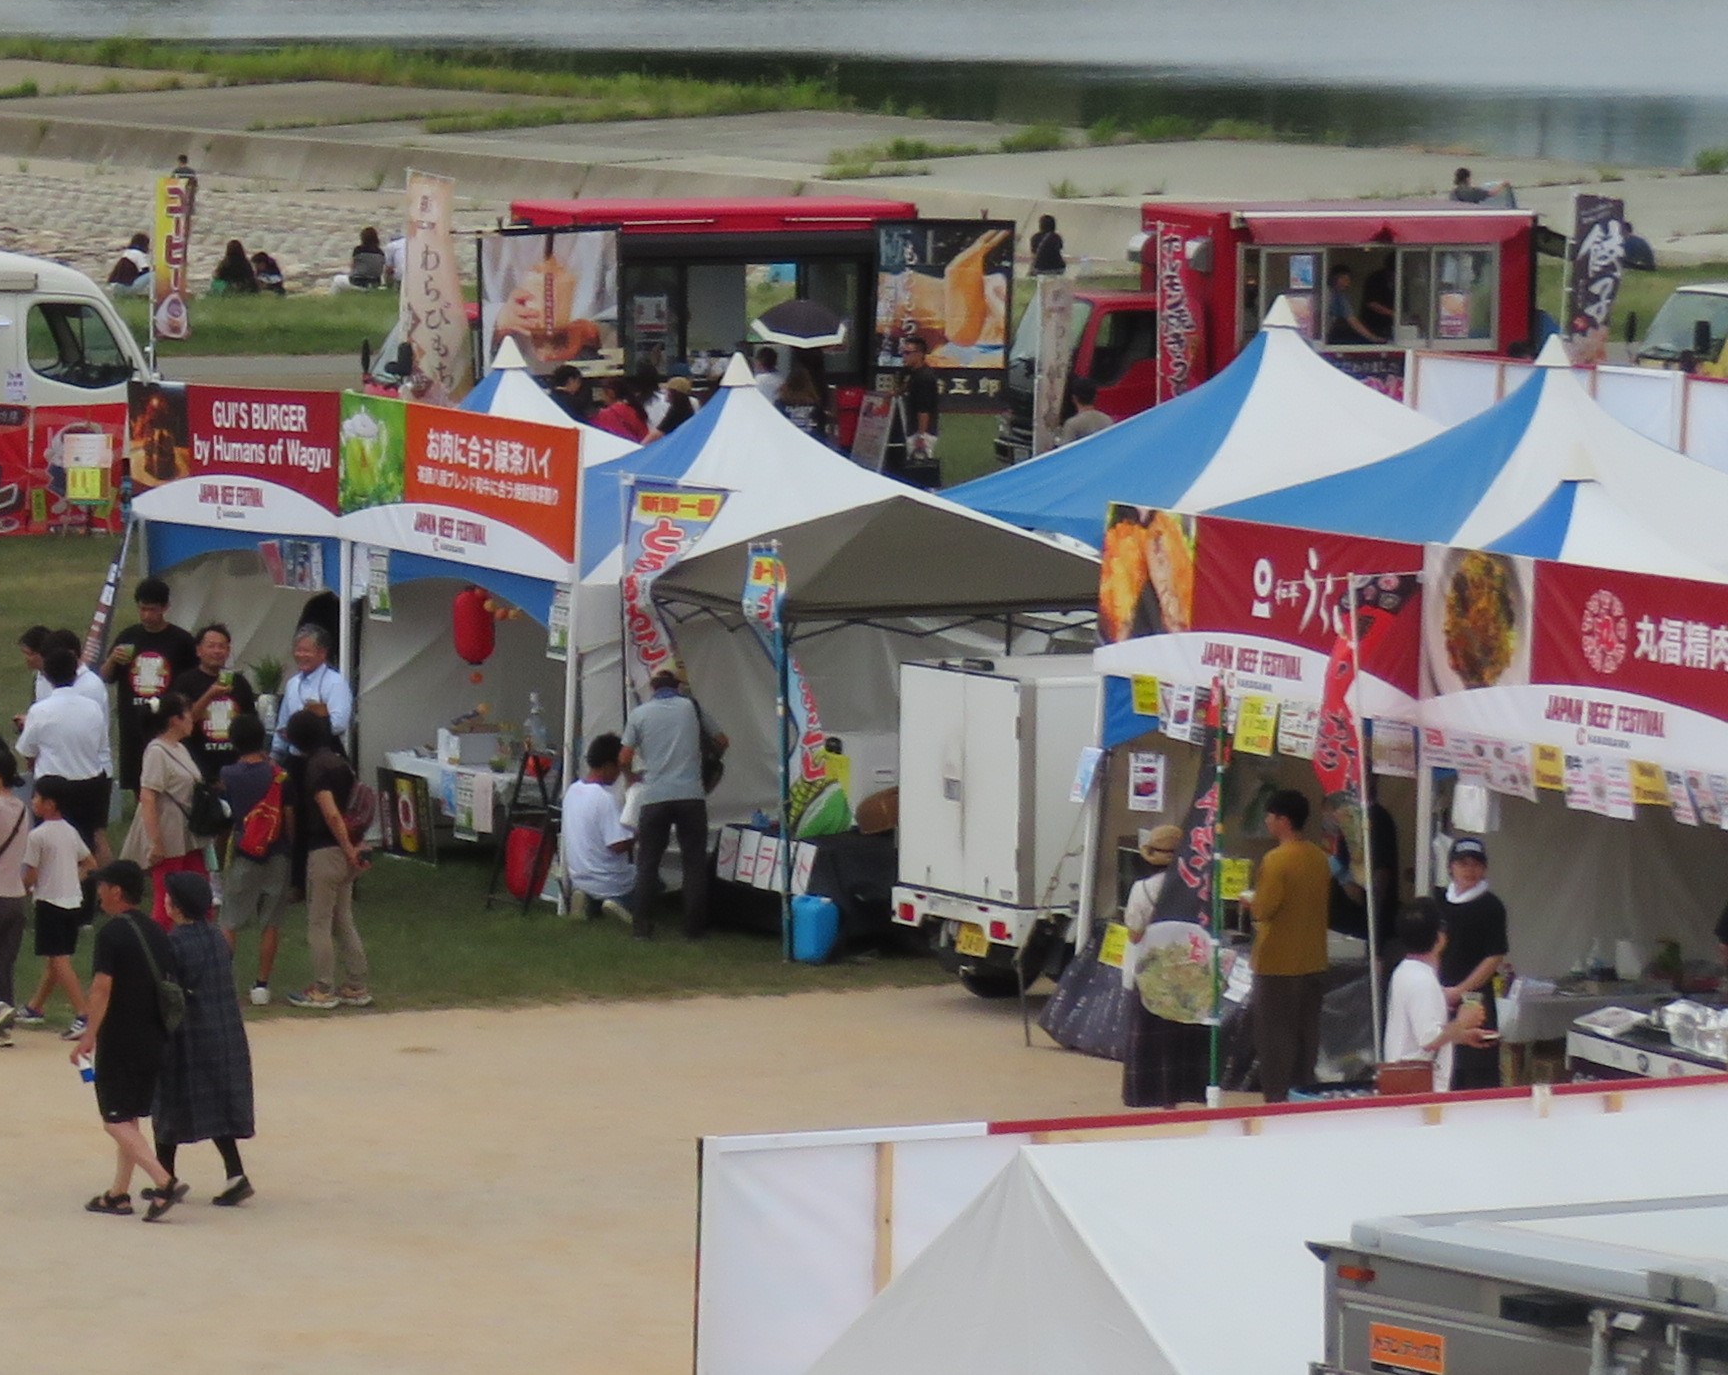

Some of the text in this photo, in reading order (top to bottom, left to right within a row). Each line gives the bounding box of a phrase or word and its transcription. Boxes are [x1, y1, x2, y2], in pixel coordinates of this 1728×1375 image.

[166, 186, 187, 293] コーヒー
[420, 242, 455, 390] わらびもち
[212, 400, 309, 432] GUI'S BURGER
[193, 433, 332, 474] by Humans of Wagyu
[426, 427, 554, 479] お肉に合う緑茶ハイ
[220, 484, 235, 506] BEEF
[438, 515, 455, 539] BEEF
[1201, 640, 1303, 682] JAPAN BEEF FESTIVAL
[1545, 693, 1666, 739] JAPAN BEEF FESTIVAL
